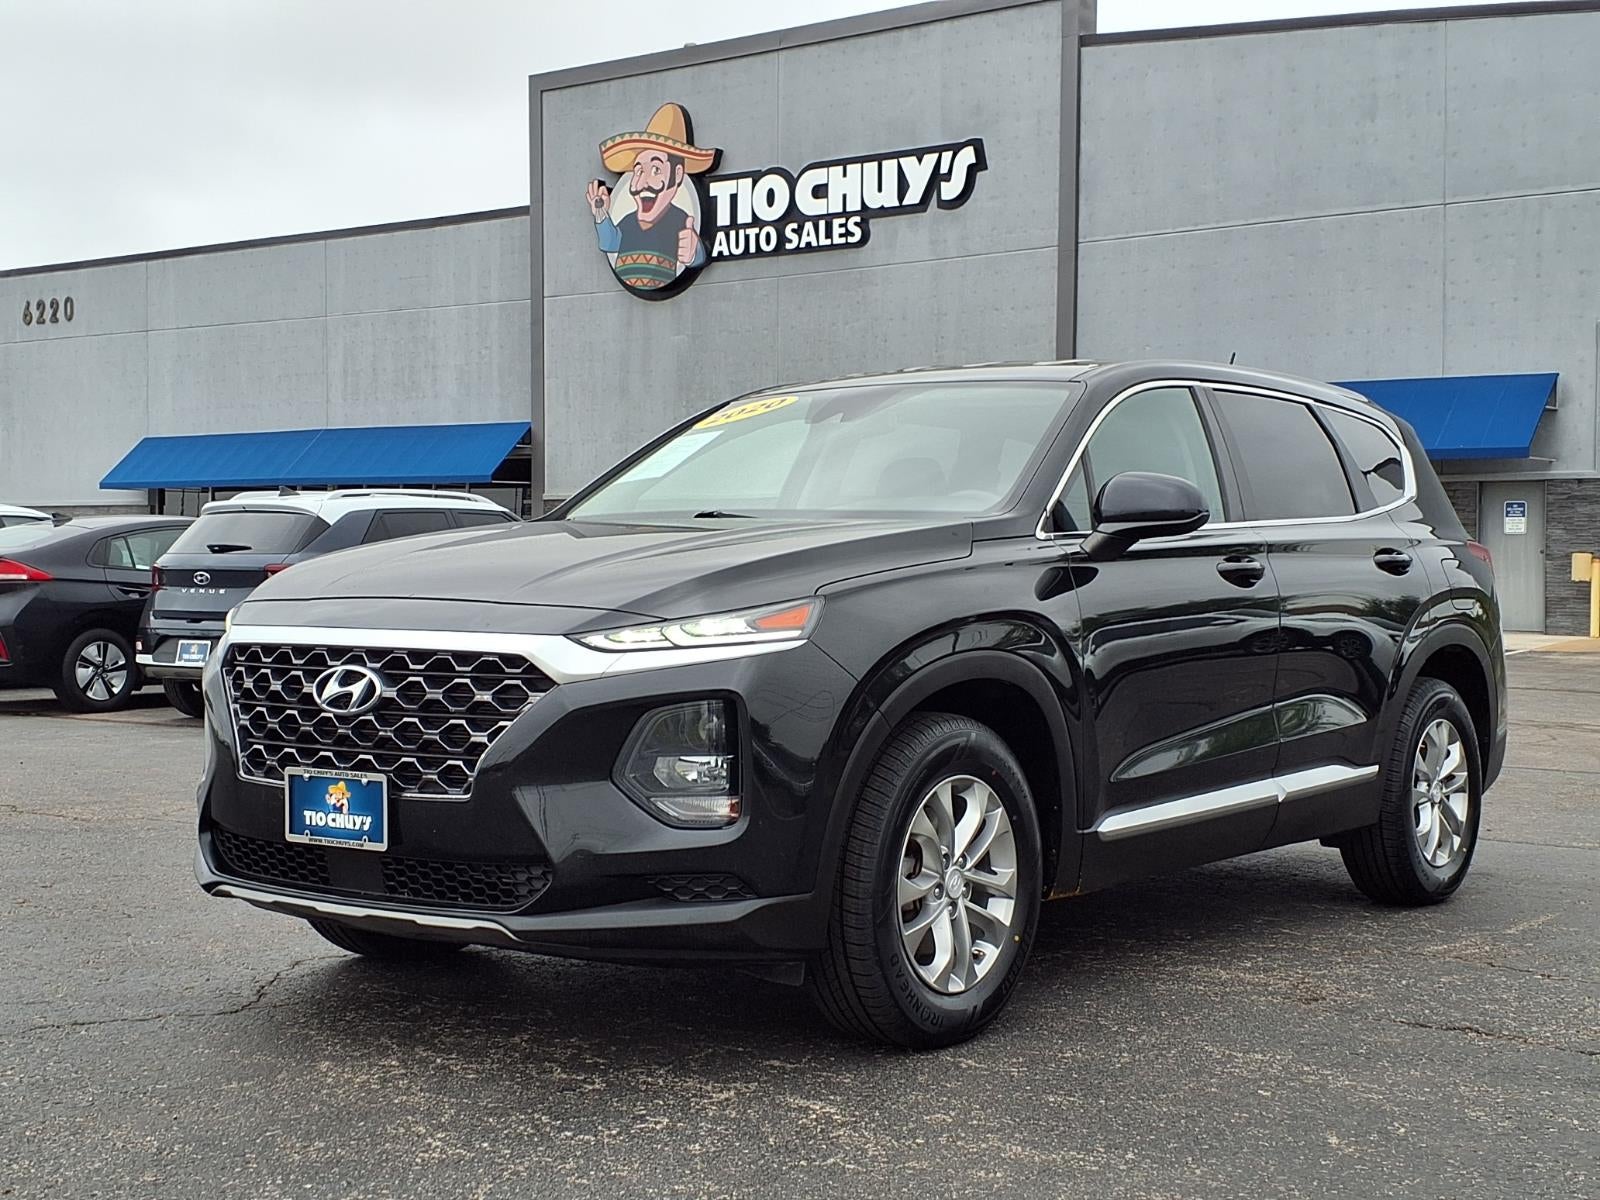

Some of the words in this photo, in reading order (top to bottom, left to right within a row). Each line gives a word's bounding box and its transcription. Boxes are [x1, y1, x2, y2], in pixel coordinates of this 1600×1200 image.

[709, 174, 790, 226] TIO
[795, 145, 977, 216] CHUY'S
[711, 227, 777, 258] AUTO
[784, 215, 862, 250] SALES
[22, 296, 74, 327] 6220
[303, 810, 326, 826] TIO
[327, 812, 372, 830] CHUY'S
